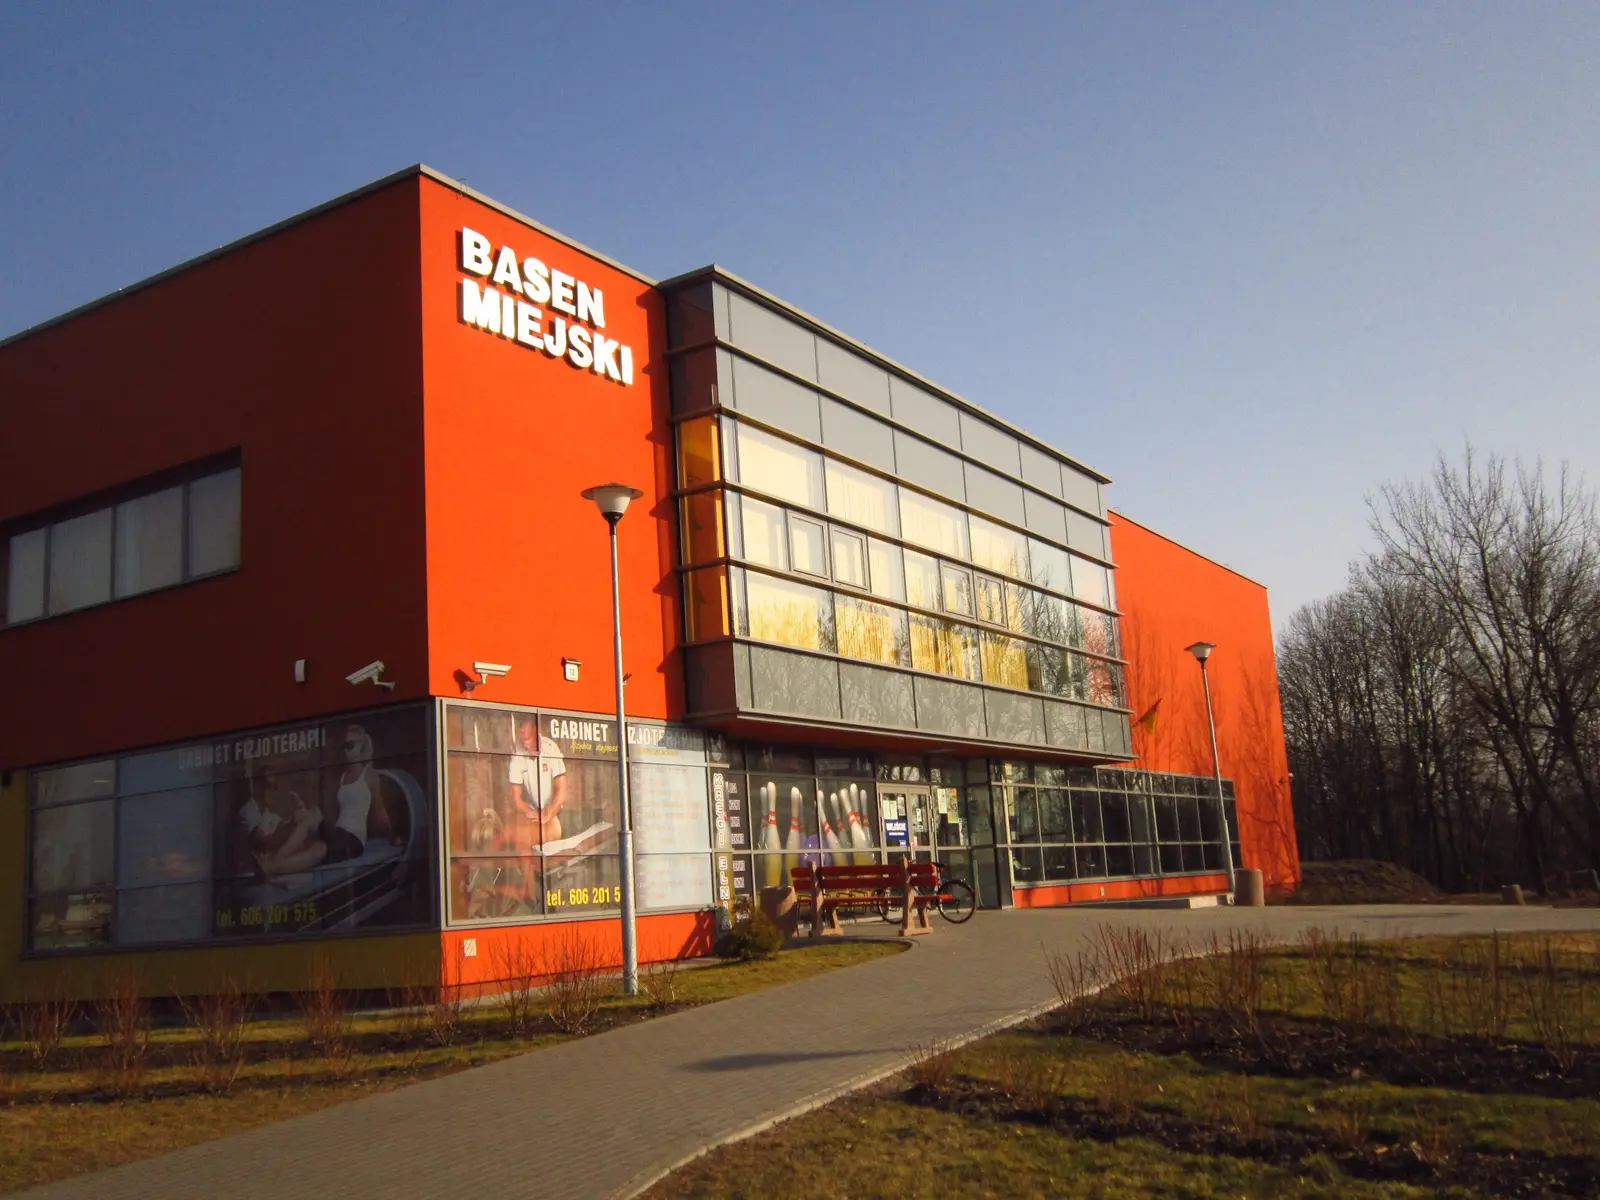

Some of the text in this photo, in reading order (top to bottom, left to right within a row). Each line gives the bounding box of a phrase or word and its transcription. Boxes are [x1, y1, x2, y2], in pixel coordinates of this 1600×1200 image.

[462, 226, 606, 328] BASEN
[462, 278, 633, 385] MIEJSKI
[550, 719, 609, 742] GABINET
[178, 727, 327, 770] GABINET FIZJOTERAPII
[547, 890, 565, 906] tel.
[569, 888, 589, 905] 606
[592, 887, 610, 904] 201
[216, 902, 317, 929] tel. 606 201 575
